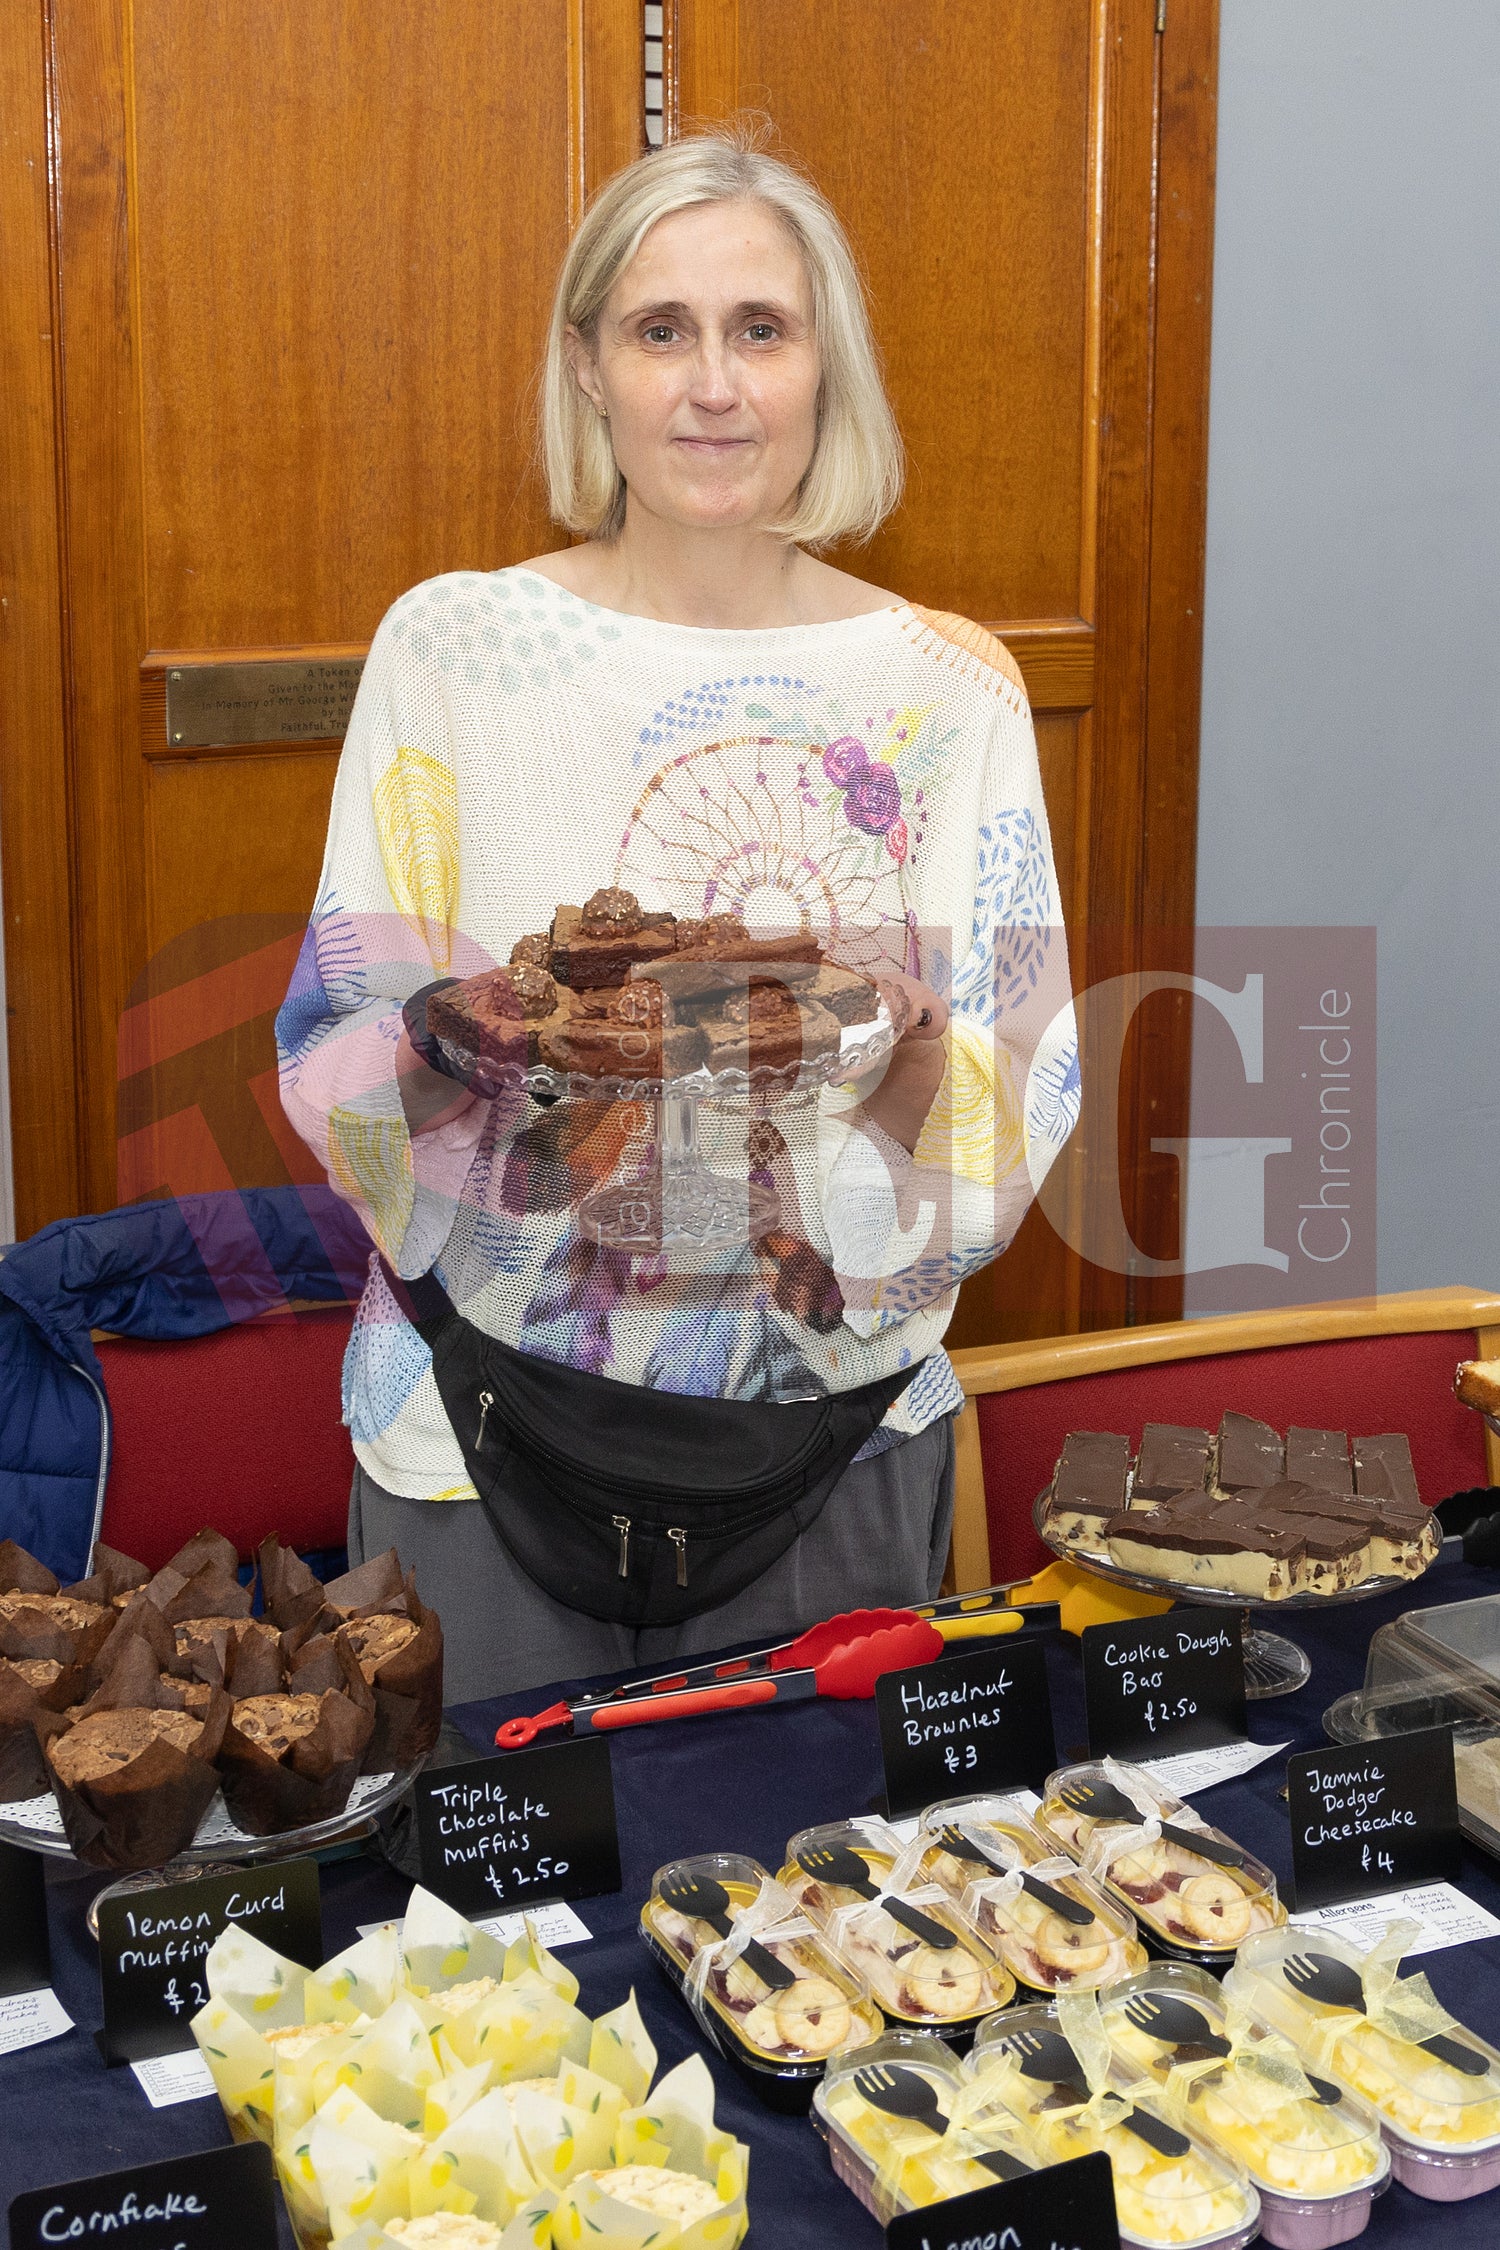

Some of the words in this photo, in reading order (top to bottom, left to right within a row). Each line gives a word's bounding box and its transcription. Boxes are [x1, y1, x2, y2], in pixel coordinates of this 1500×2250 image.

[268, 684, 298, 695] Given
[318, 680, 335, 690] the
[306, 669, 314, 678] A
[320, 667, 350, 677] Token
[216, 699, 259, 711] Memory
[1104, 1644, 1169, 1667] Cookie
[1176, 1629, 1232, 1656] Dough
[901, 1668, 1013, 1714] Hazelnut
[1306, 1759, 1385, 1793] Jammie
[430, 1782, 508, 1812] Triple
[1322, 1786, 1386, 1817] Dodger
[1304, 1808, 1417, 1846] Cheesecake
[224, 1886, 285, 1918] Curd
[1318, 1902, 1376, 1919] Allergens
[120, 1934, 220, 1974] muffin
